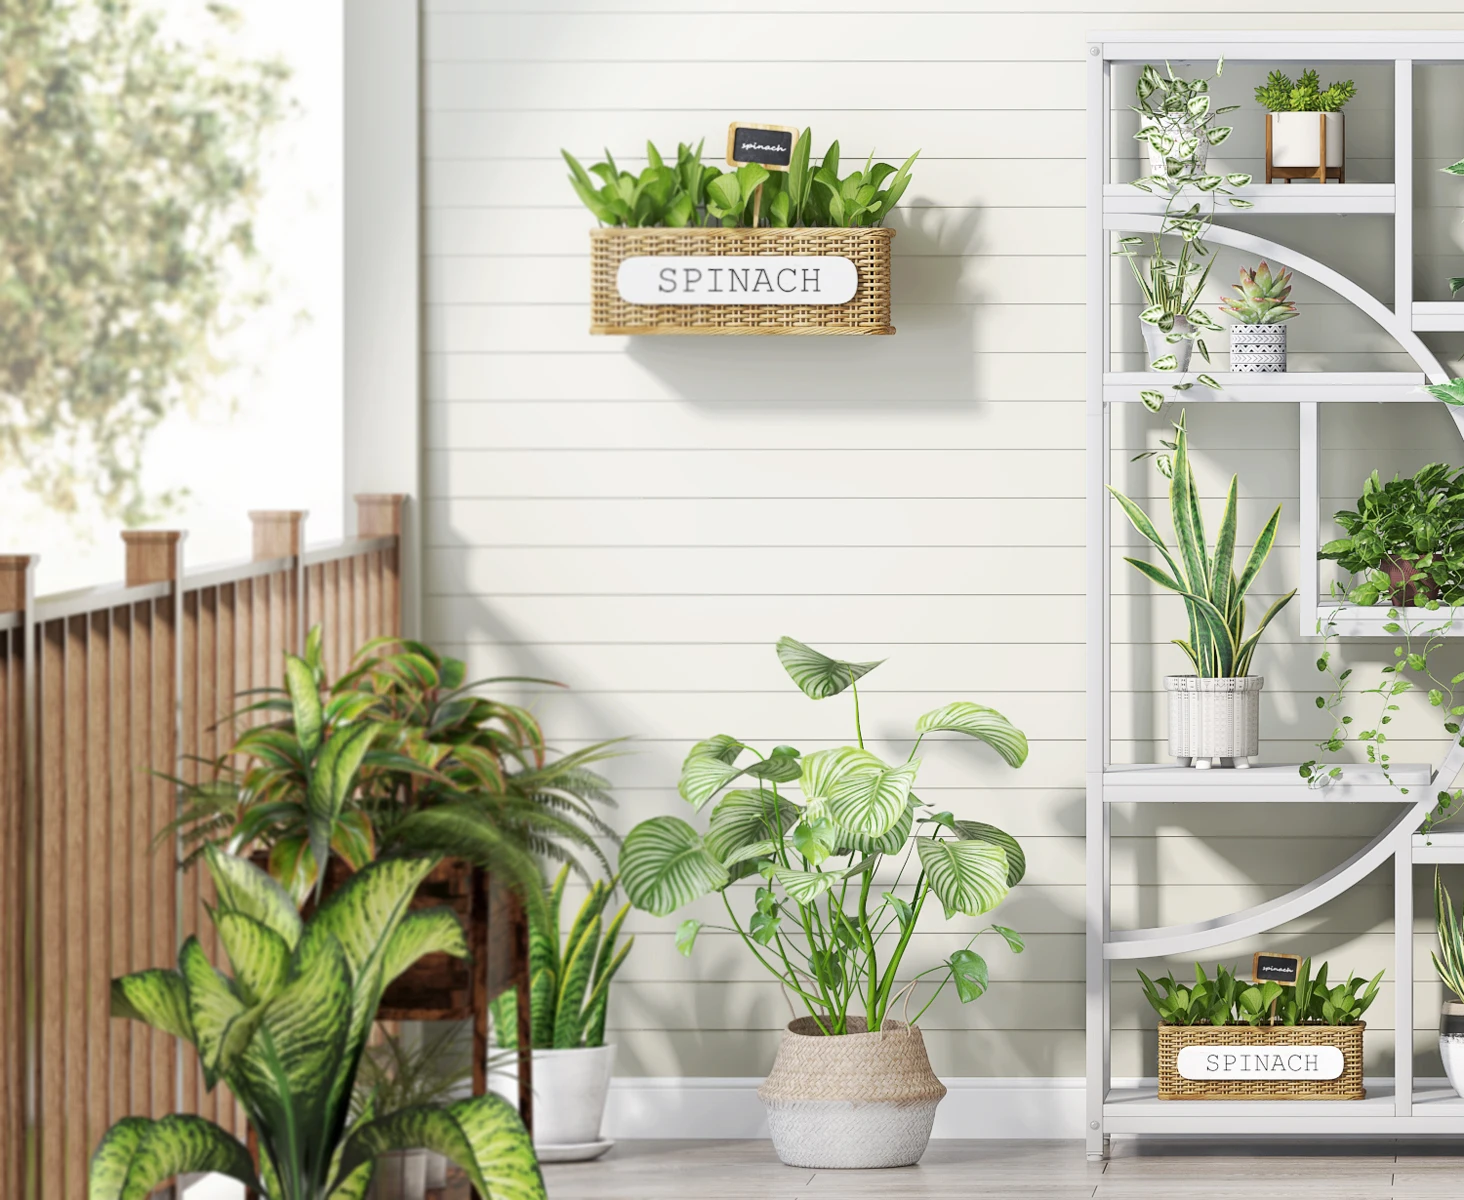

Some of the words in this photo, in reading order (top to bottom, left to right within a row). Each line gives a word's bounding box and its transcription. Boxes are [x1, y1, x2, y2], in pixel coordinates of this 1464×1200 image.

[741, 142, 786, 152] spinach
[658, 267, 821, 293] SPINACH
[1206, 1054, 1319, 1072] SPINACH
